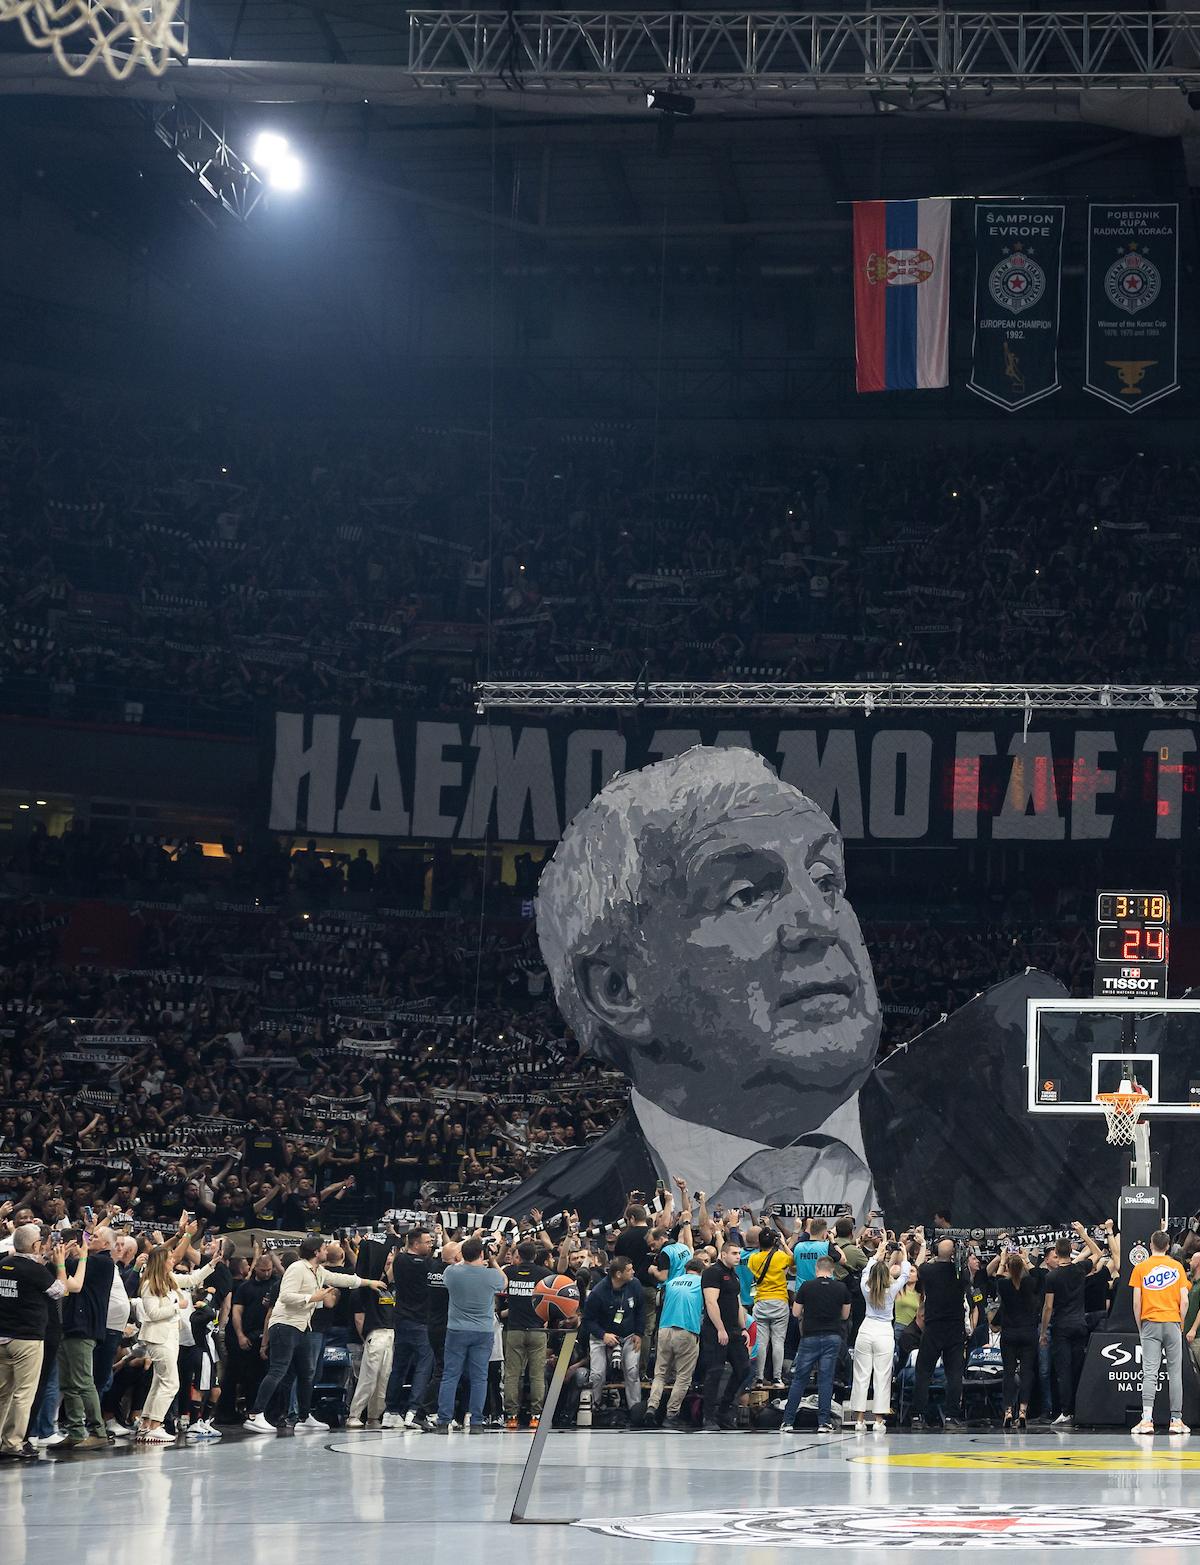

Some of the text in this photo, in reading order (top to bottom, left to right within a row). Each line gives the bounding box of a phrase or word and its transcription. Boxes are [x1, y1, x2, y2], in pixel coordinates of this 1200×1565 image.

[986, 213, 1054, 224] ŠAMPION
[1107, 211, 1160, 219] POBEDNIK
[1120, 219, 1147, 227] KUPA
[989, 227, 1050, 236] EVROPE
[1094, 227, 1135, 235] RADIVOJA
[980, 320, 1052, 329] EUROPEAN CHAMPION
[1155, 320, 1167, 328] Cup
[953, 730, 1119, 840] ГДЕ
[1115, 896, 1163, 918] 3:18
[1124, 929, 1162, 959] 24
[1102, 978, 1159, 990] TISSOT
[1124, 1196, 1155, 1205] SPALDING
[784, 1204, 837, 1217] PARTIZAN
[800, 1252, 818, 1260] PHOTO
[671, 1279, 692, 1288] PHOTO
[1118, 1382, 1163, 1391] NA DU
